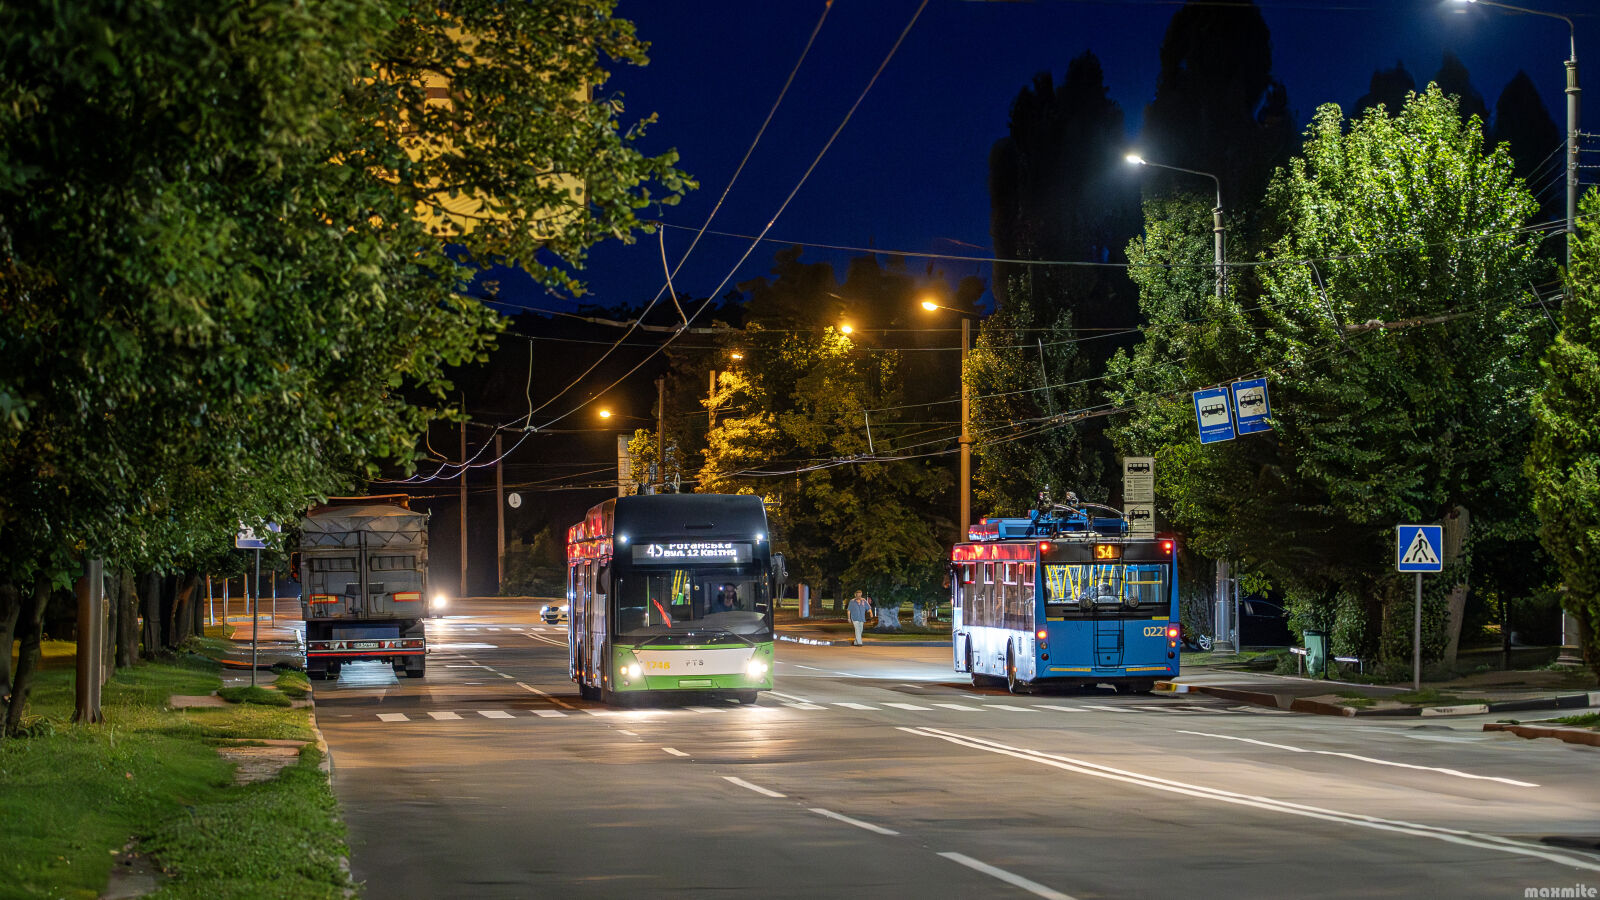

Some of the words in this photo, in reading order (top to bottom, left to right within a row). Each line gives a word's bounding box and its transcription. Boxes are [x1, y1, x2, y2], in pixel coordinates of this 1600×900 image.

[647, 544, 663, 557] 45
[1098, 545, 1113, 559] 54
[1143, 626, 1168, 637] 0221
